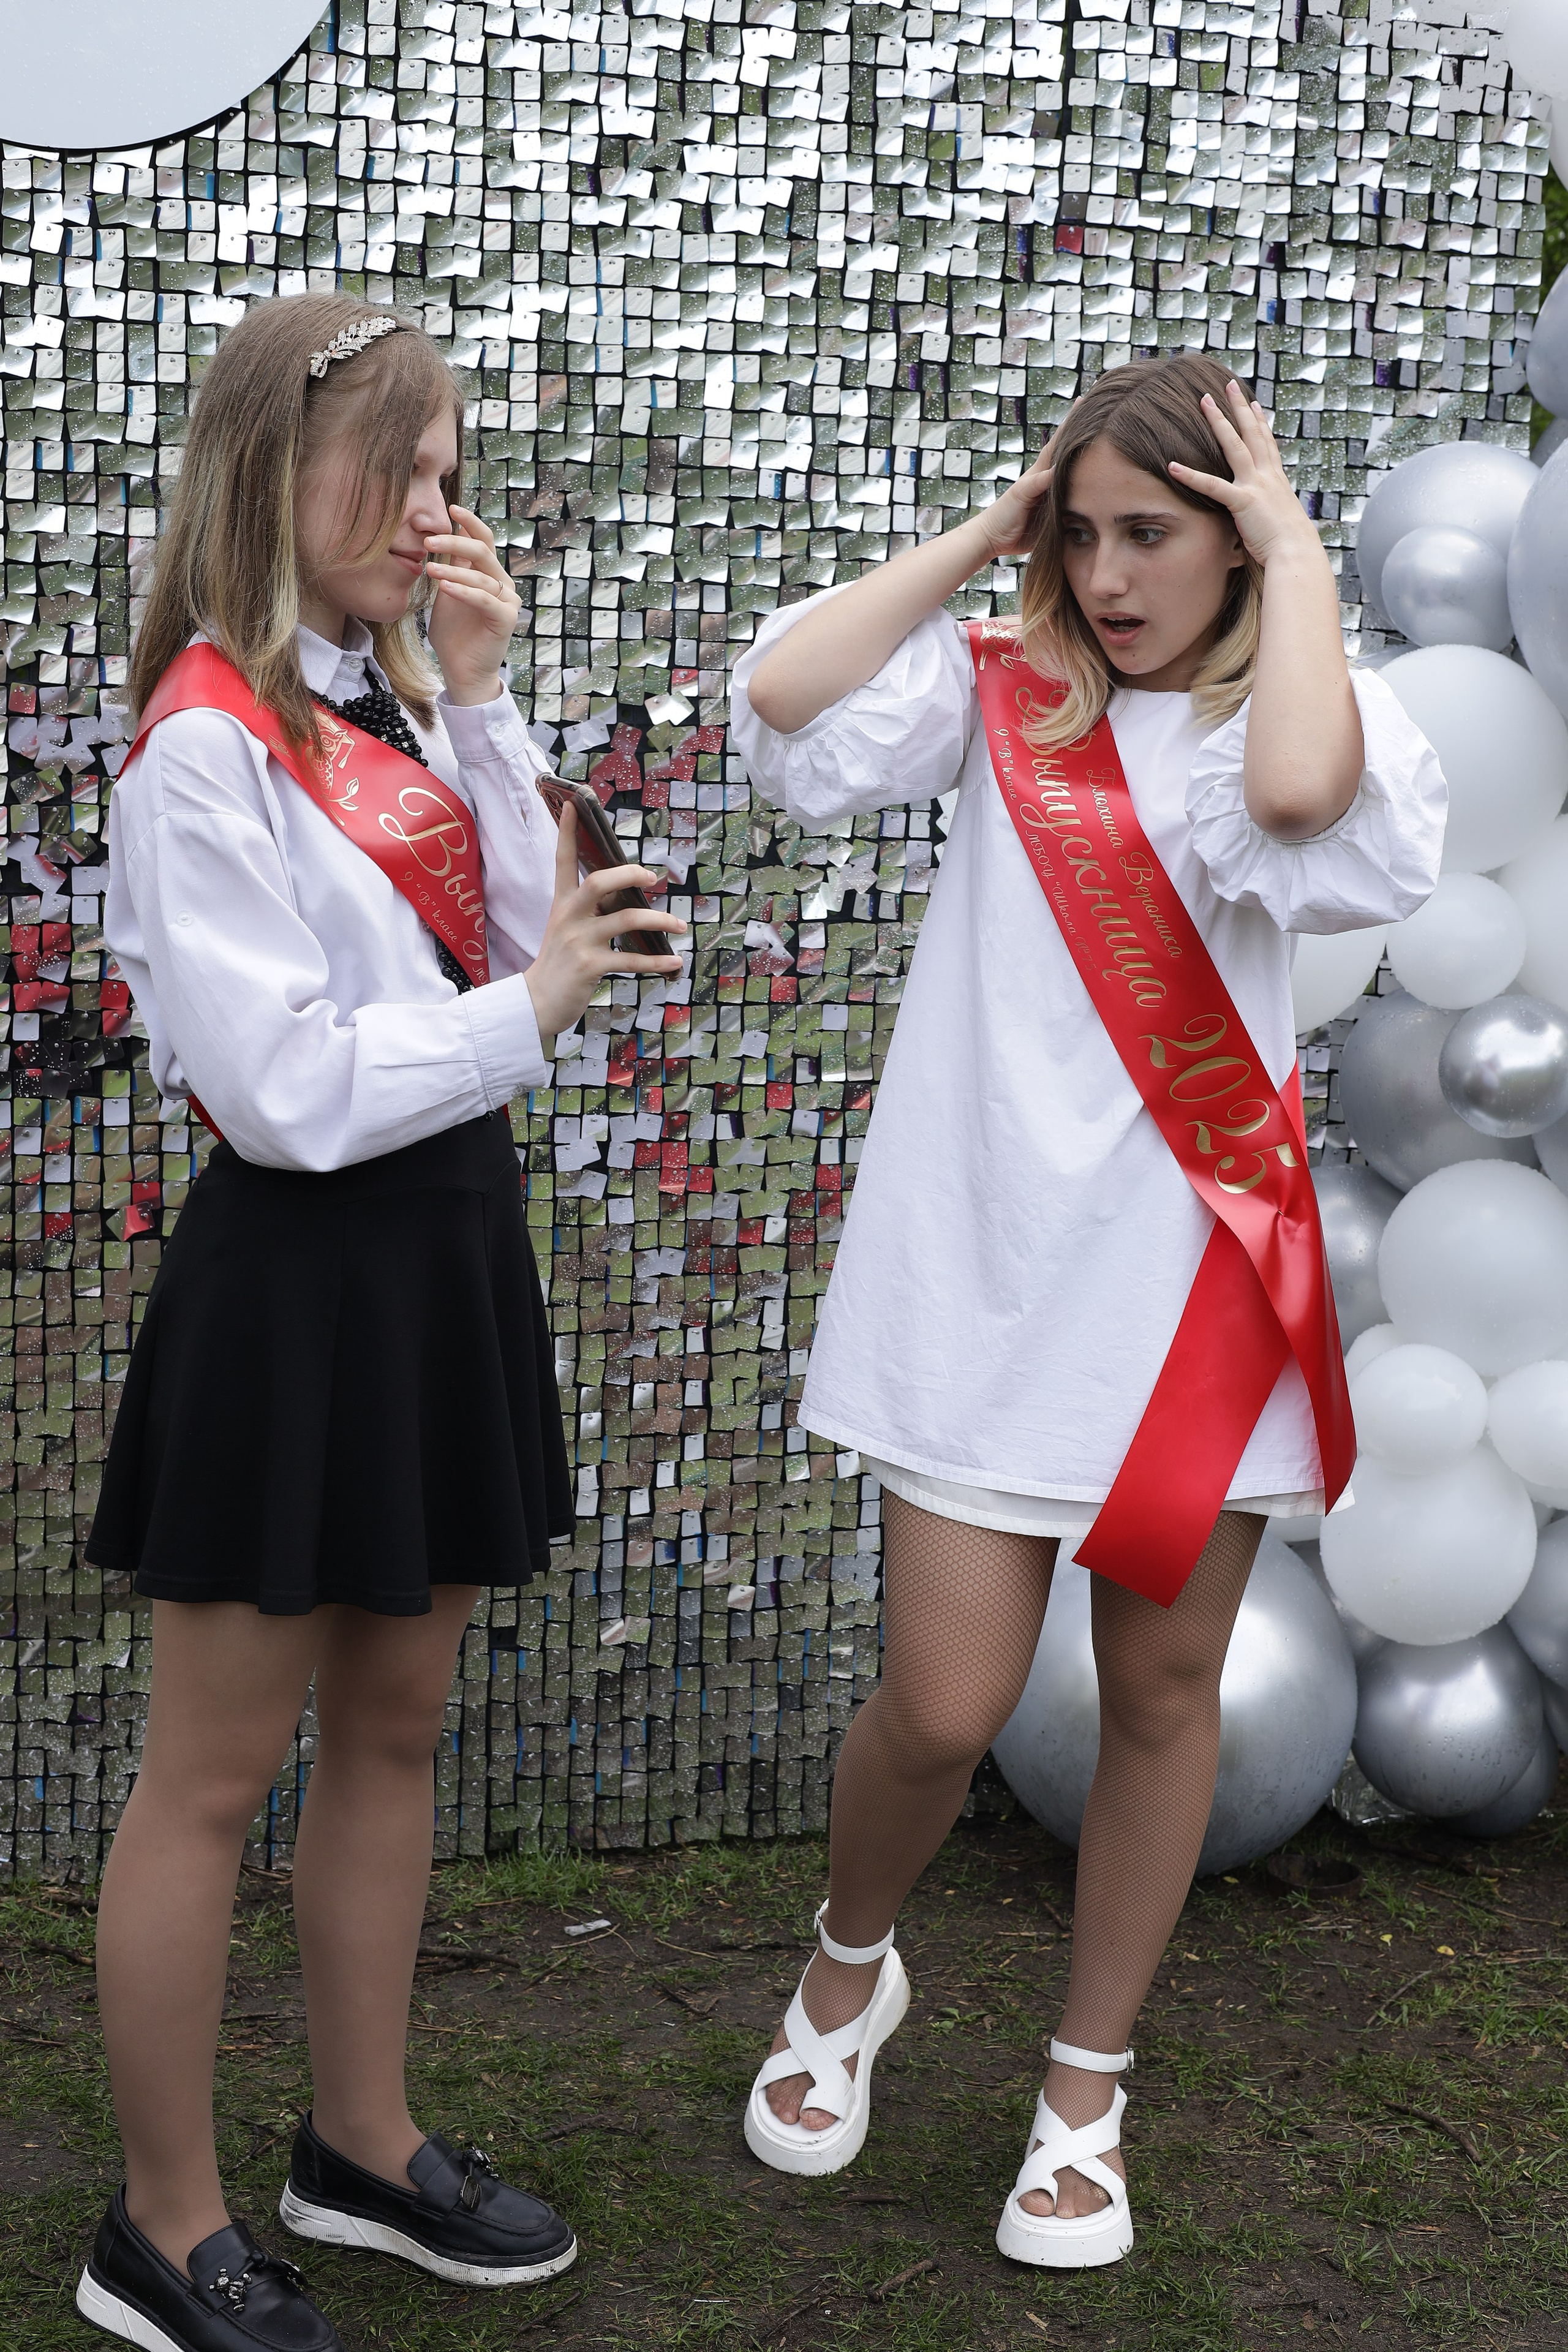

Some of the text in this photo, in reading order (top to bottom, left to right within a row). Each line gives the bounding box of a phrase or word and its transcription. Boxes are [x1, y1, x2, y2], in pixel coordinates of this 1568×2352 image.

[993, 728, 1009, 737] 9
[1001, 766, 1017, 801] класс
[1025, 829, 1055, 880] МБОУ
[1086, 767, 1183, 959] Блохина Вероника
[399, 870, 414, 883] 9
[432, 909, 459, 943] класс
[1137, 1014, 1300, 1195] 2025
